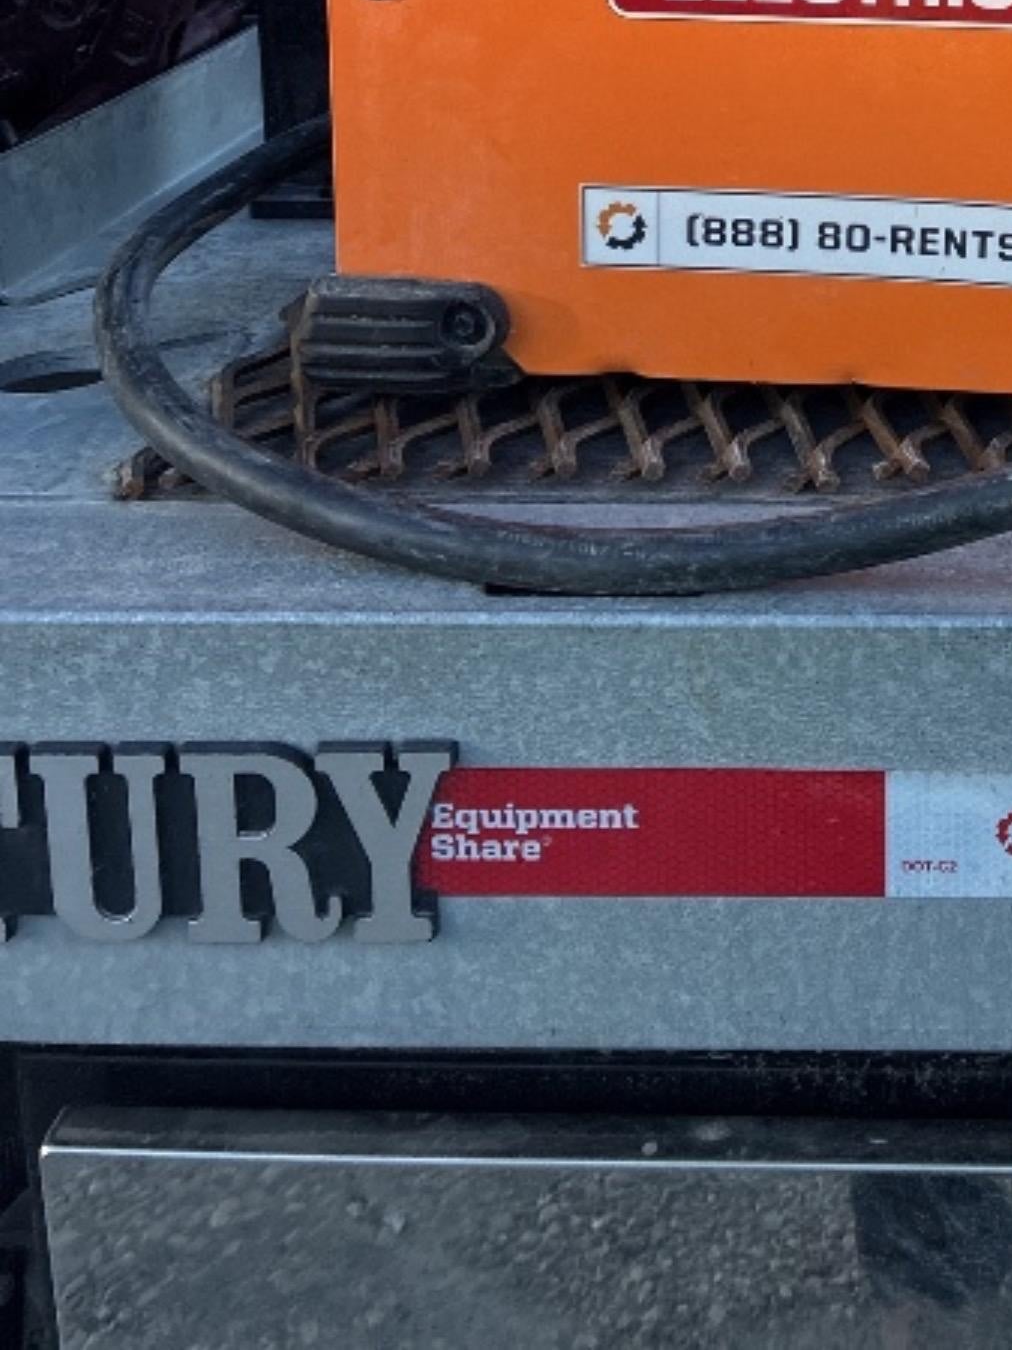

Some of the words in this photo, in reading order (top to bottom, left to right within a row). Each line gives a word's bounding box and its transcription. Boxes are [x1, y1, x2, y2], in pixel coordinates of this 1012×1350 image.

[686, 213, 799, 251] (888)
[431, 801, 639, 834] Equipment
[430, 834, 543, 862] Share
